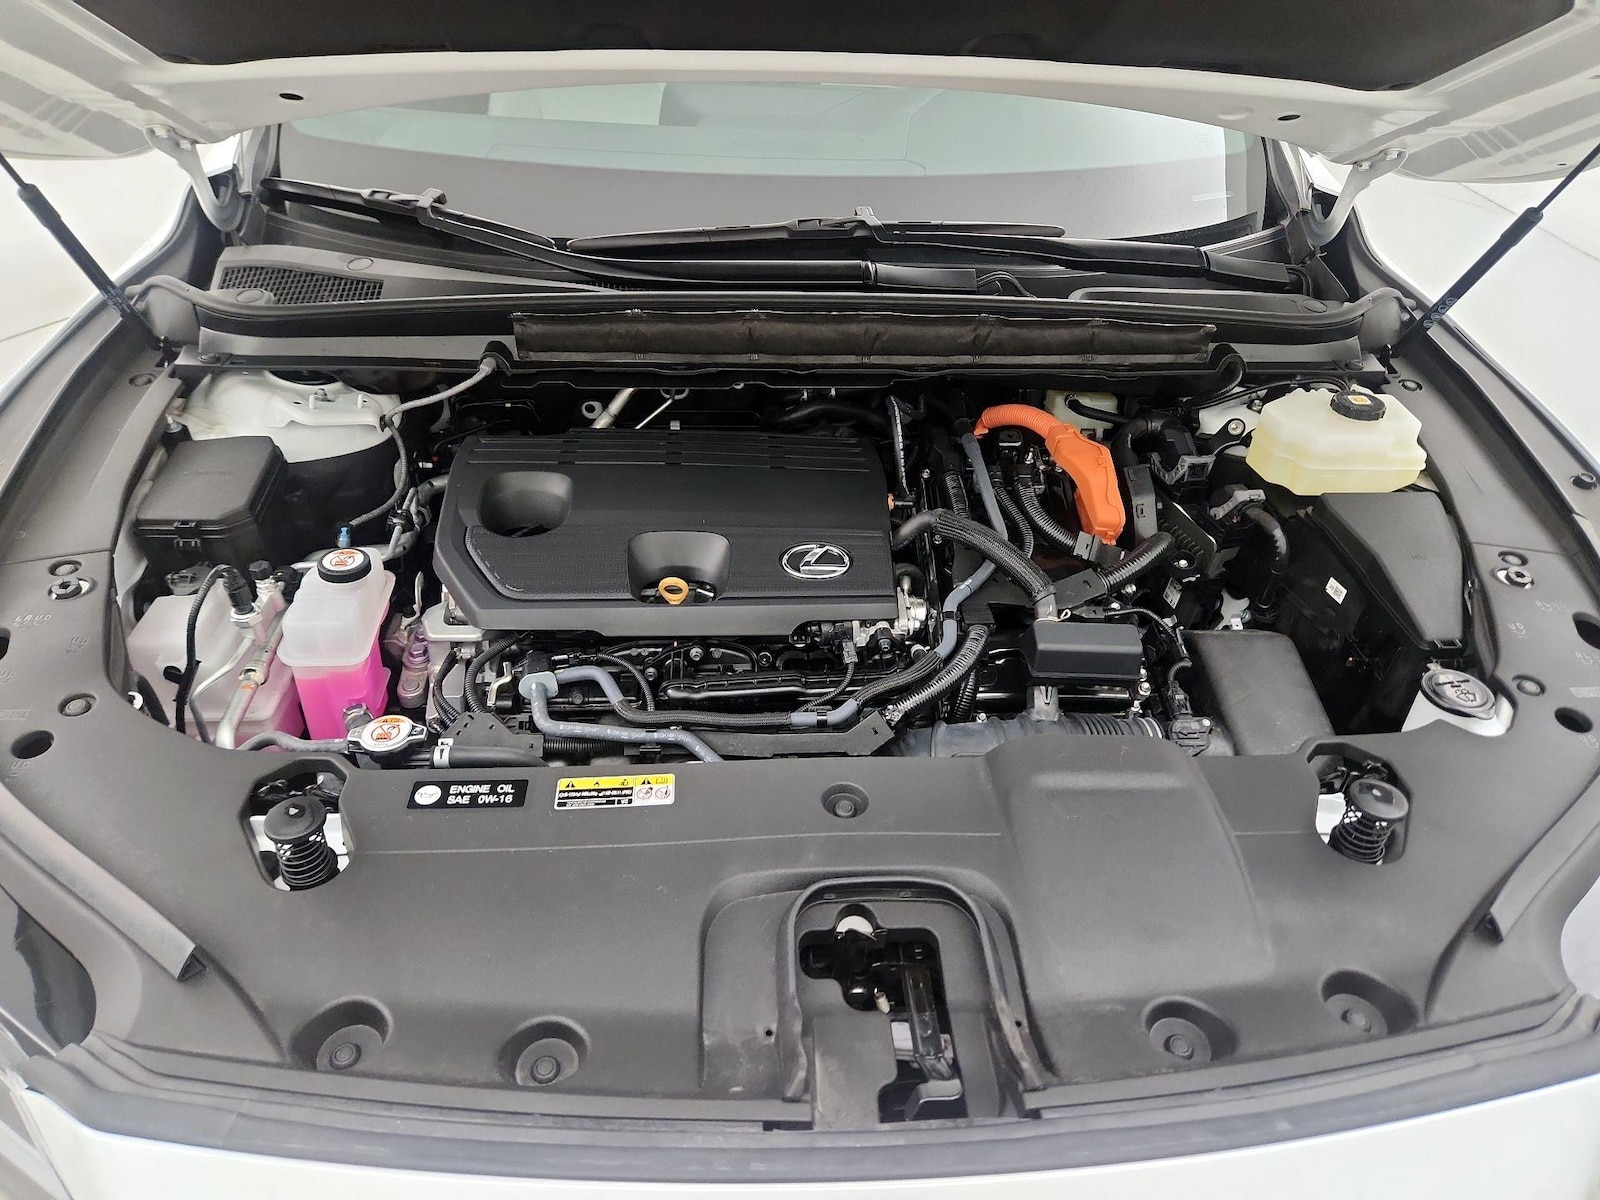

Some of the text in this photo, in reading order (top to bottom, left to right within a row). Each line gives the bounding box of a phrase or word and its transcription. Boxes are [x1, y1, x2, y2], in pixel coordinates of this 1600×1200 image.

[449, 784, 515, 794] ENGINE OIL
[446, 795, 471, 804] SAE
[477, 795, 513, 804] 0W-16
